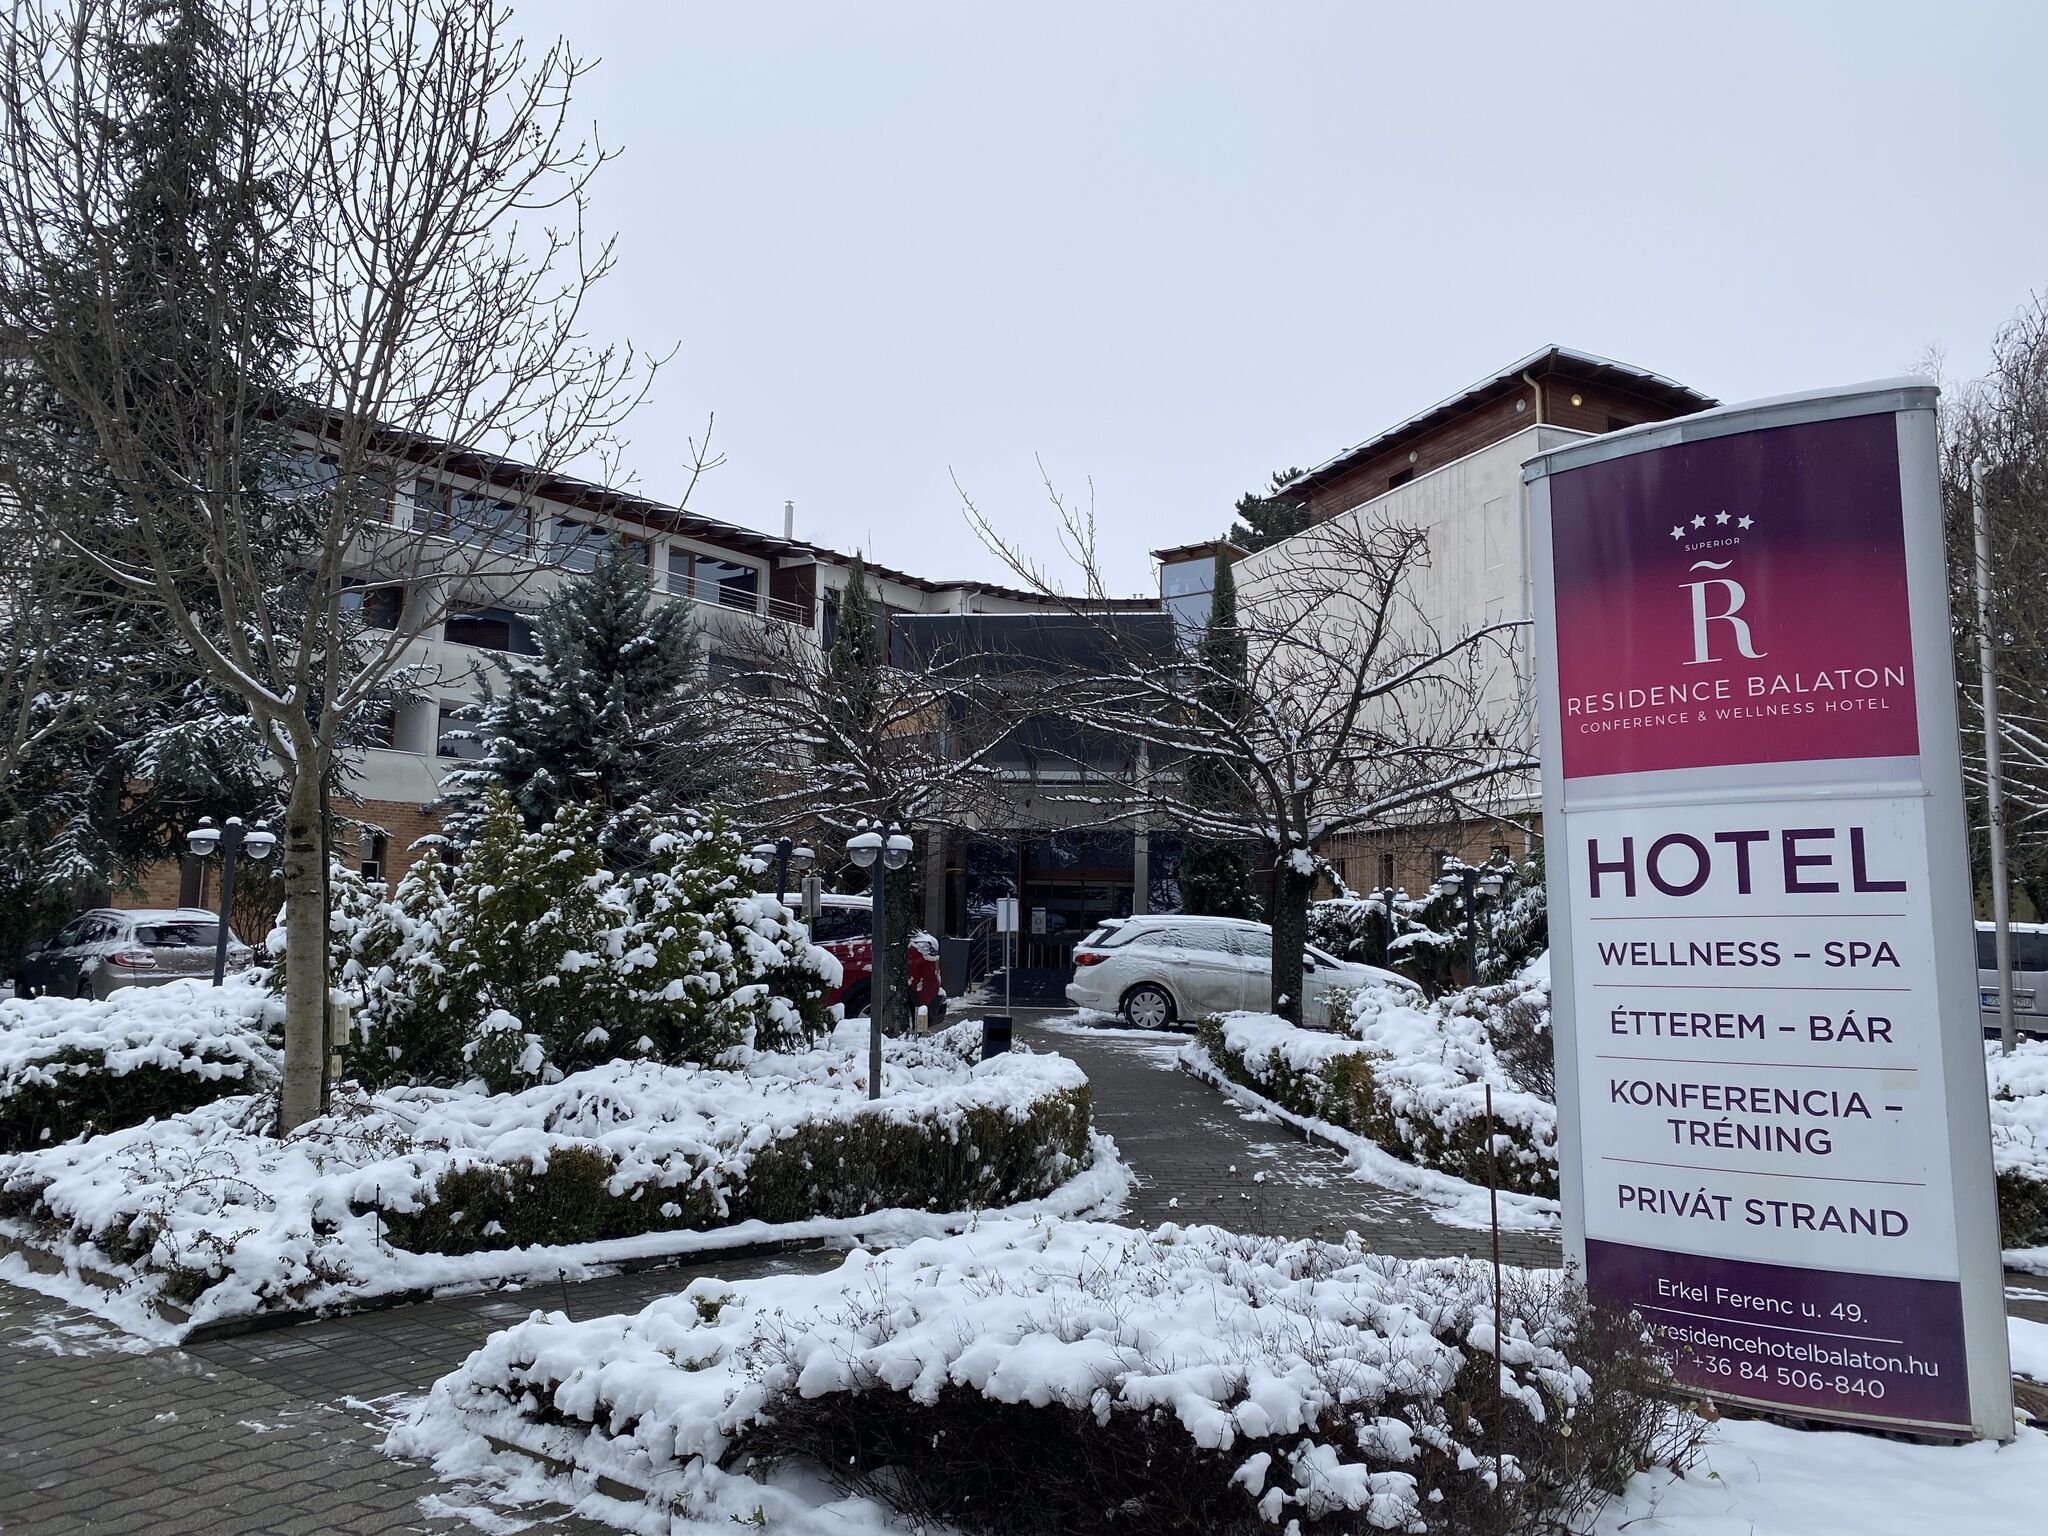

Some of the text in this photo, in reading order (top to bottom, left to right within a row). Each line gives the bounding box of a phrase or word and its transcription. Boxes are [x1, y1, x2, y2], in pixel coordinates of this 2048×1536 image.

[1685, 537, 1740, 551] SUPERIOR
[1568, 666, 1905, 716] RESIDENCE BALATON
[1581, 698, 1890, 734] CONFERENCE & WELLNESS HOTEL
[1587, 827, 1907, 898] HOTEL
[1598, 941, 1781, 967] WELLNESS
[1824, 941, 1901, 968] SPA
[1610, 1004, 1766, 1040] ÉTTEREM
[1809, 1009, 1894, 1043] BÁR
[1610, 1079, 1872, 1119] KONFERENCIA
[1667, 1116, 1832, 1155] TRÉNING
[1618, 1184, 1909, 1237] PRIVÁT STRAND
[1658, 1279, 1869, 1323] Erkel Ferenc u. 49.
[1692, 1355, 1732, 1376] +36
[1740, 1361, 1768, 1382] 84
[1777, 1367, 1885, 1399] 506-840
